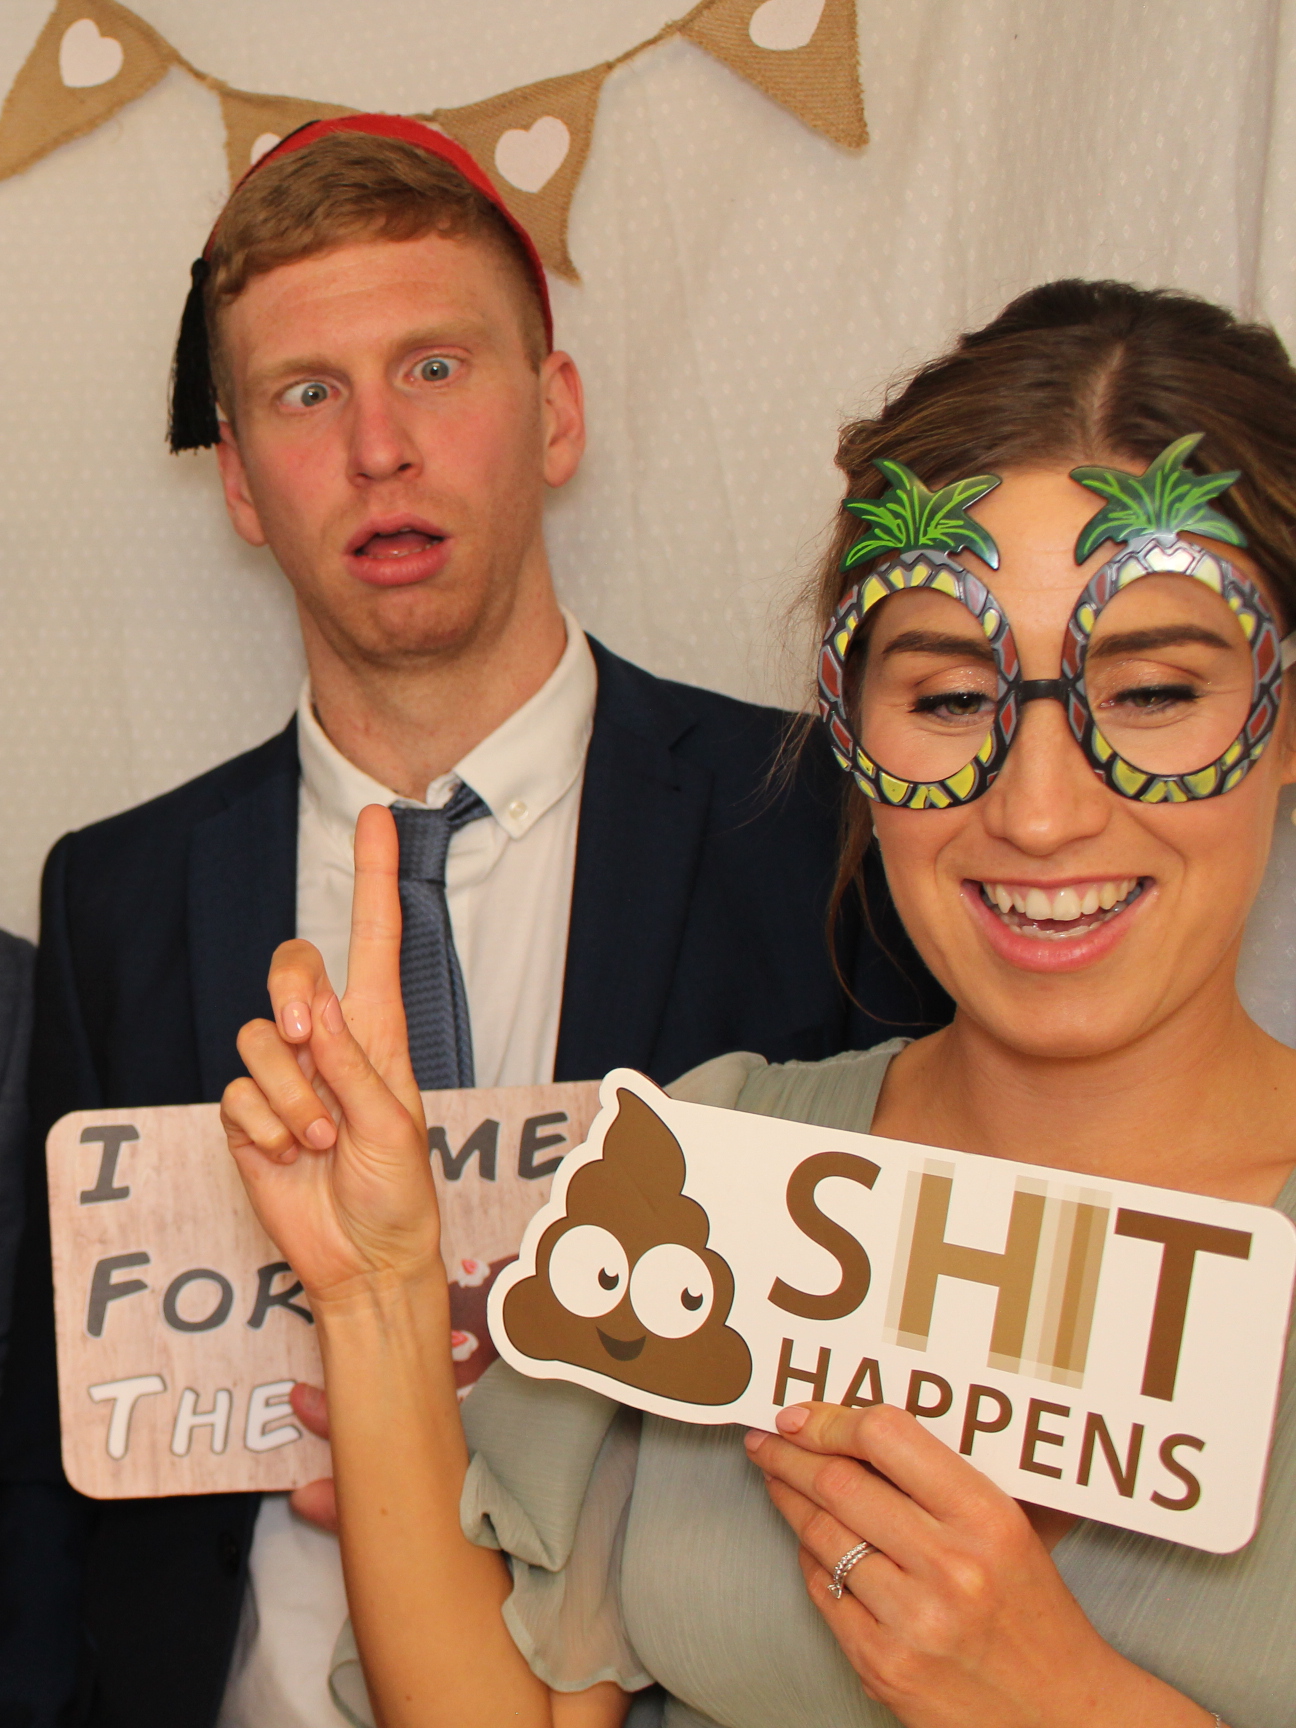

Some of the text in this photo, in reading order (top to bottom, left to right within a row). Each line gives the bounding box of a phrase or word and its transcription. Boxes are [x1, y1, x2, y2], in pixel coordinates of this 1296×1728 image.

[79, 1124, 140, 1206] I
[85, 1250, 317, 1340] FOR
[767, 1150, 1254, 1403] SHIT
[87, 1373, 304, 1462] THE
[771, 1336, 1207, 1512] HAPPENS
